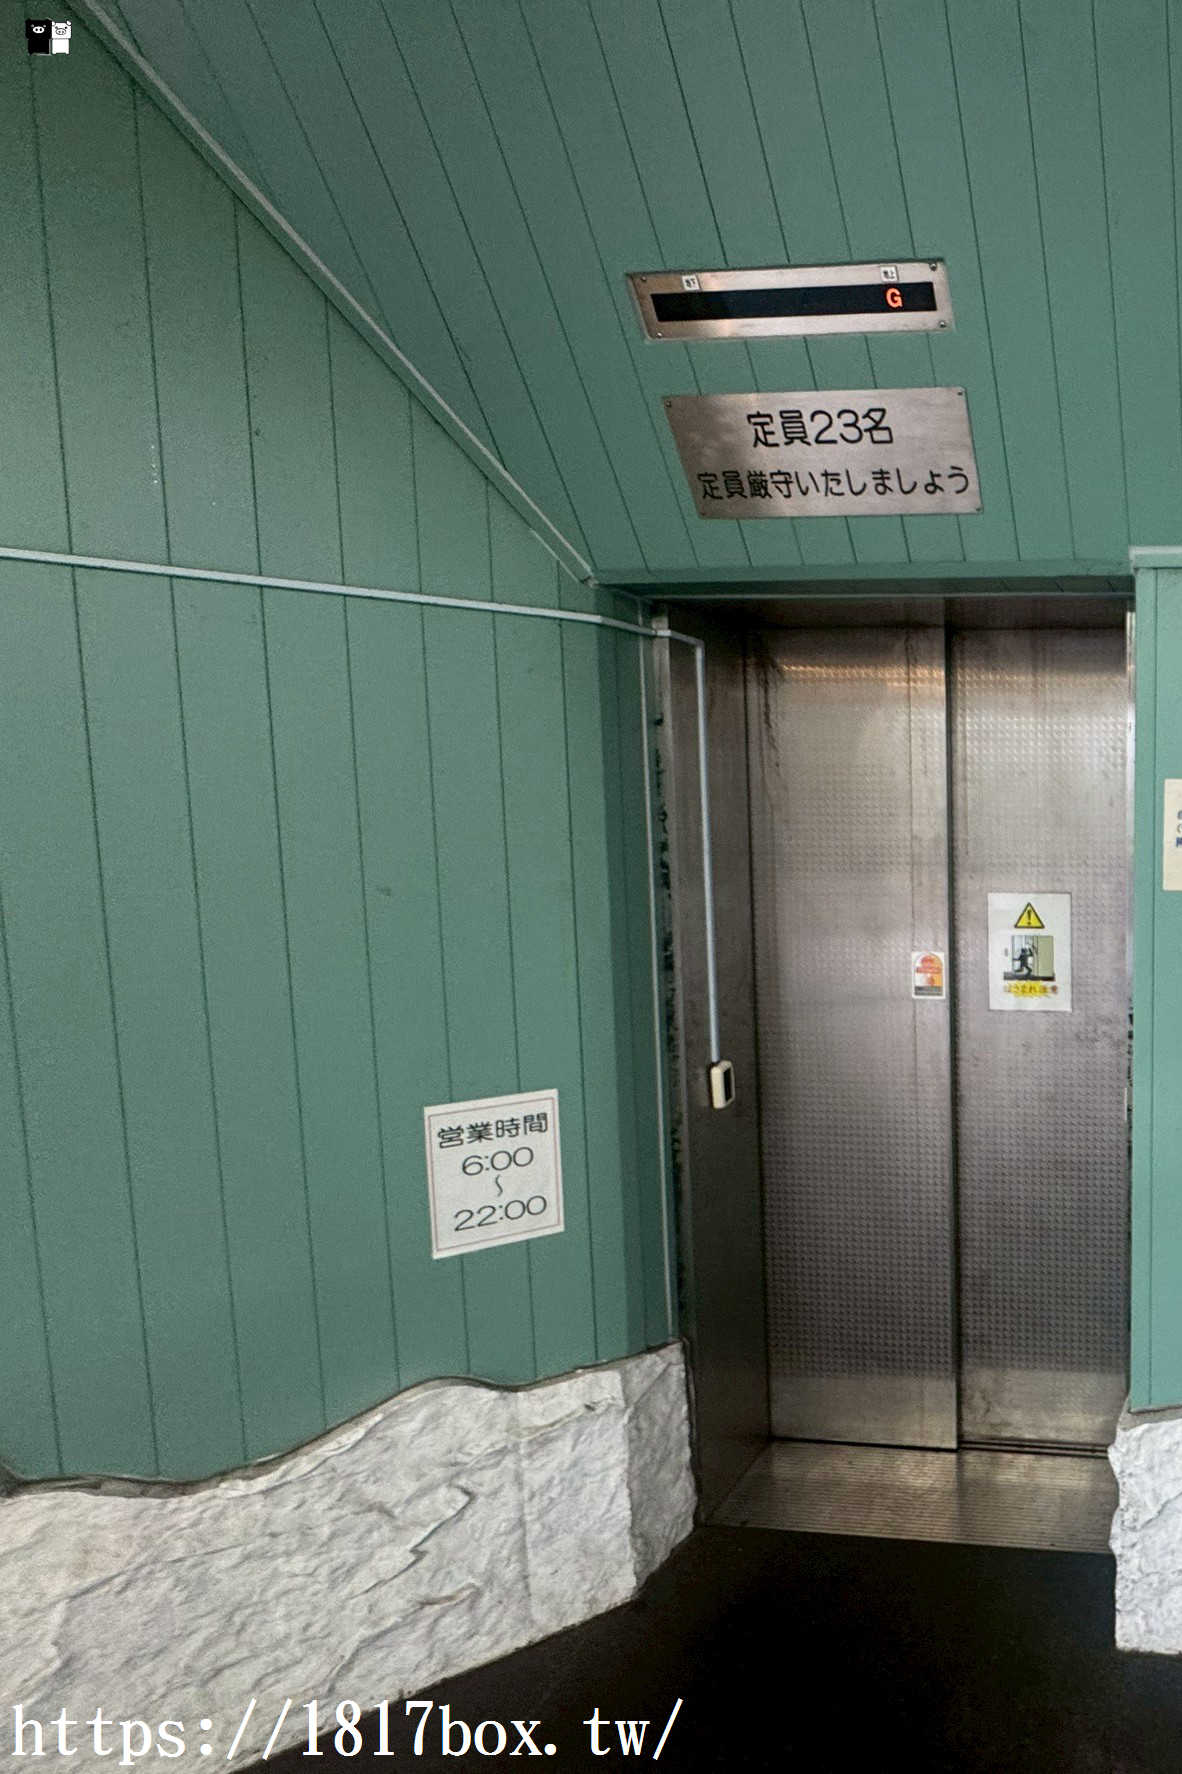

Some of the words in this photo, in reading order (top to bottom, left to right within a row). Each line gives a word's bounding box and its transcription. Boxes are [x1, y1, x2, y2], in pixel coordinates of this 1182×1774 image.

[886, 288, 903, 308] G
[748, 408, 894, 448] 定員23名
[697, 465, 969, 500] 定員厳守いたしましょう
[437, 1112, 548, 1149] 営業時間
[462, 1146, 534, 1176] 6:00
[454, 1195, 547, 1232] 22:00
